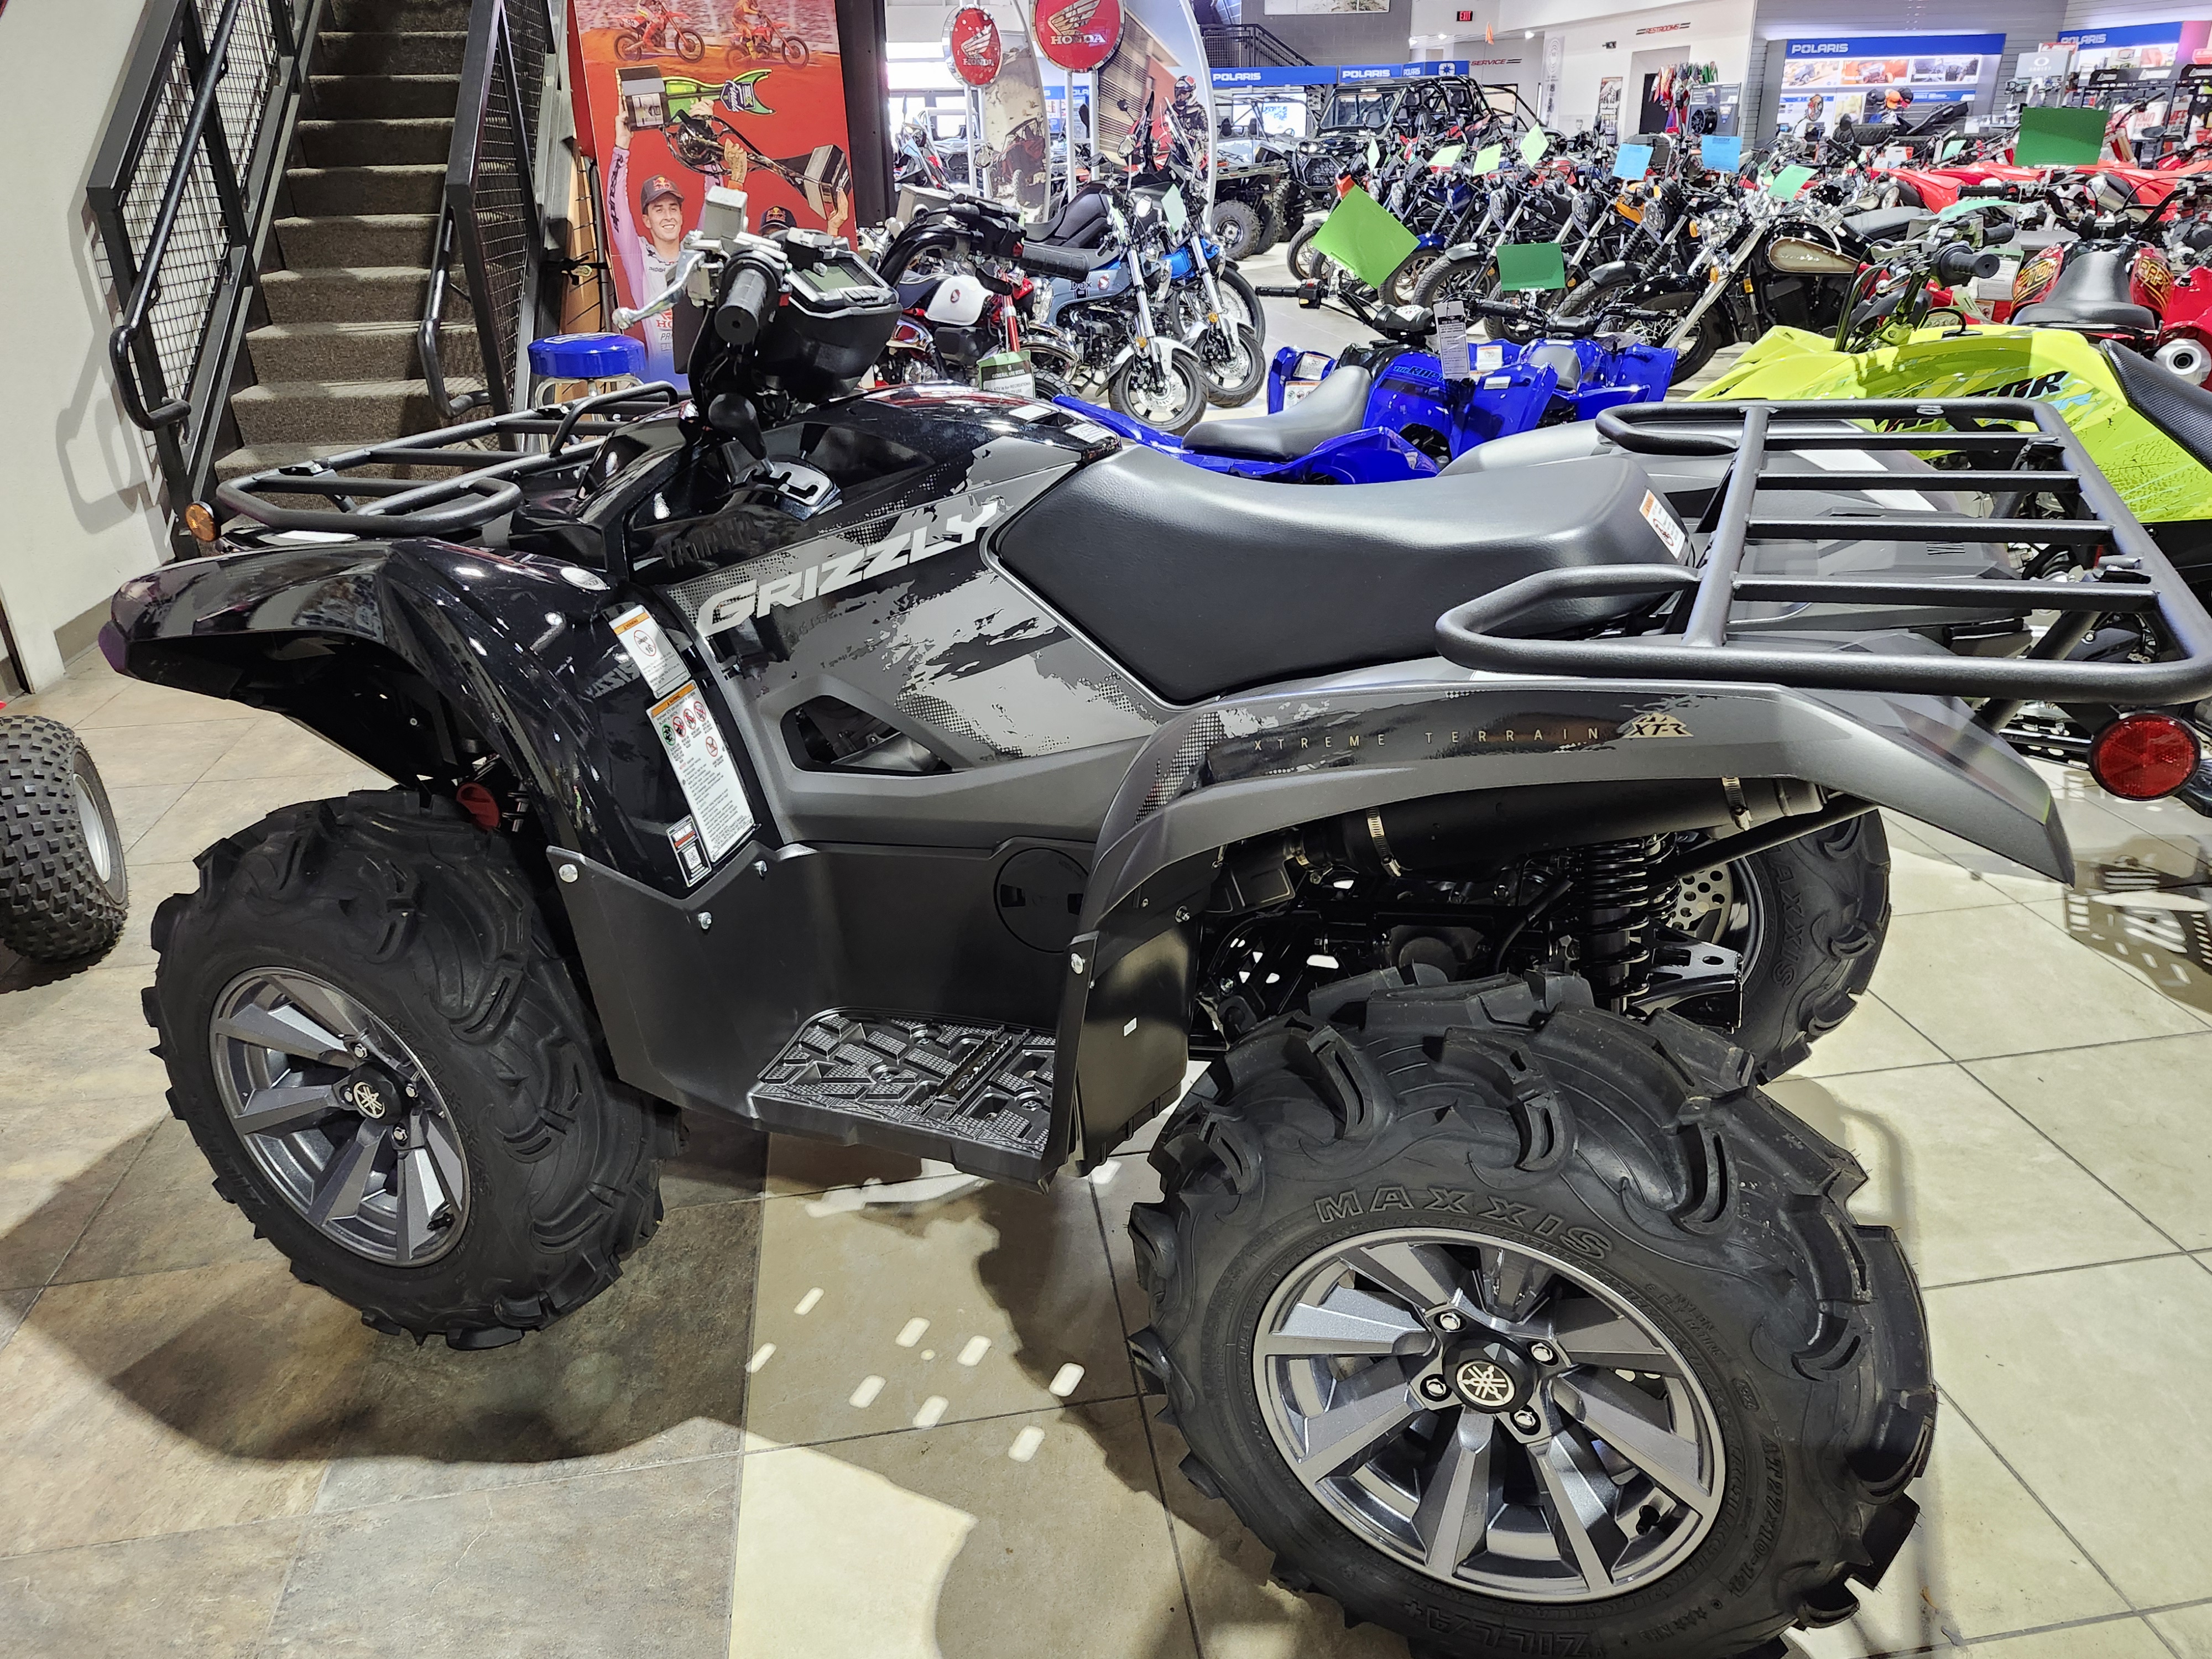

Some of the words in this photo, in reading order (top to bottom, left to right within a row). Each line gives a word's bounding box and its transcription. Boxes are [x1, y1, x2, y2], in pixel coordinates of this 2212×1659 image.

[1459, 11, 1472, 20] EXIT
[1645, 24, 1679, 34] RESTROOMS
[1051, 34, 1105, 45] HONDA
[2060, 33, 2106, 45] POLARIS
[1792, 43, 1849, 54] POLARIS
[963, 58, 994, 66] HONDA
[1213, 72, 1261, 81] POLARIS
[1342, 69, 1391, 78] POLARIS
[1404, 67, 1421, 76] POLARIS
[1070, 281, 1092, 291] Dax
[697, 500, 998, 638] GRIZZLY
[644, 643, 654, 654] 16
[1254, 733, 1386, 752] XTREME
[1426, 727, 1599, 745] TERRAIN
[1315, 1185, 1611, 1261] MAXXIS
